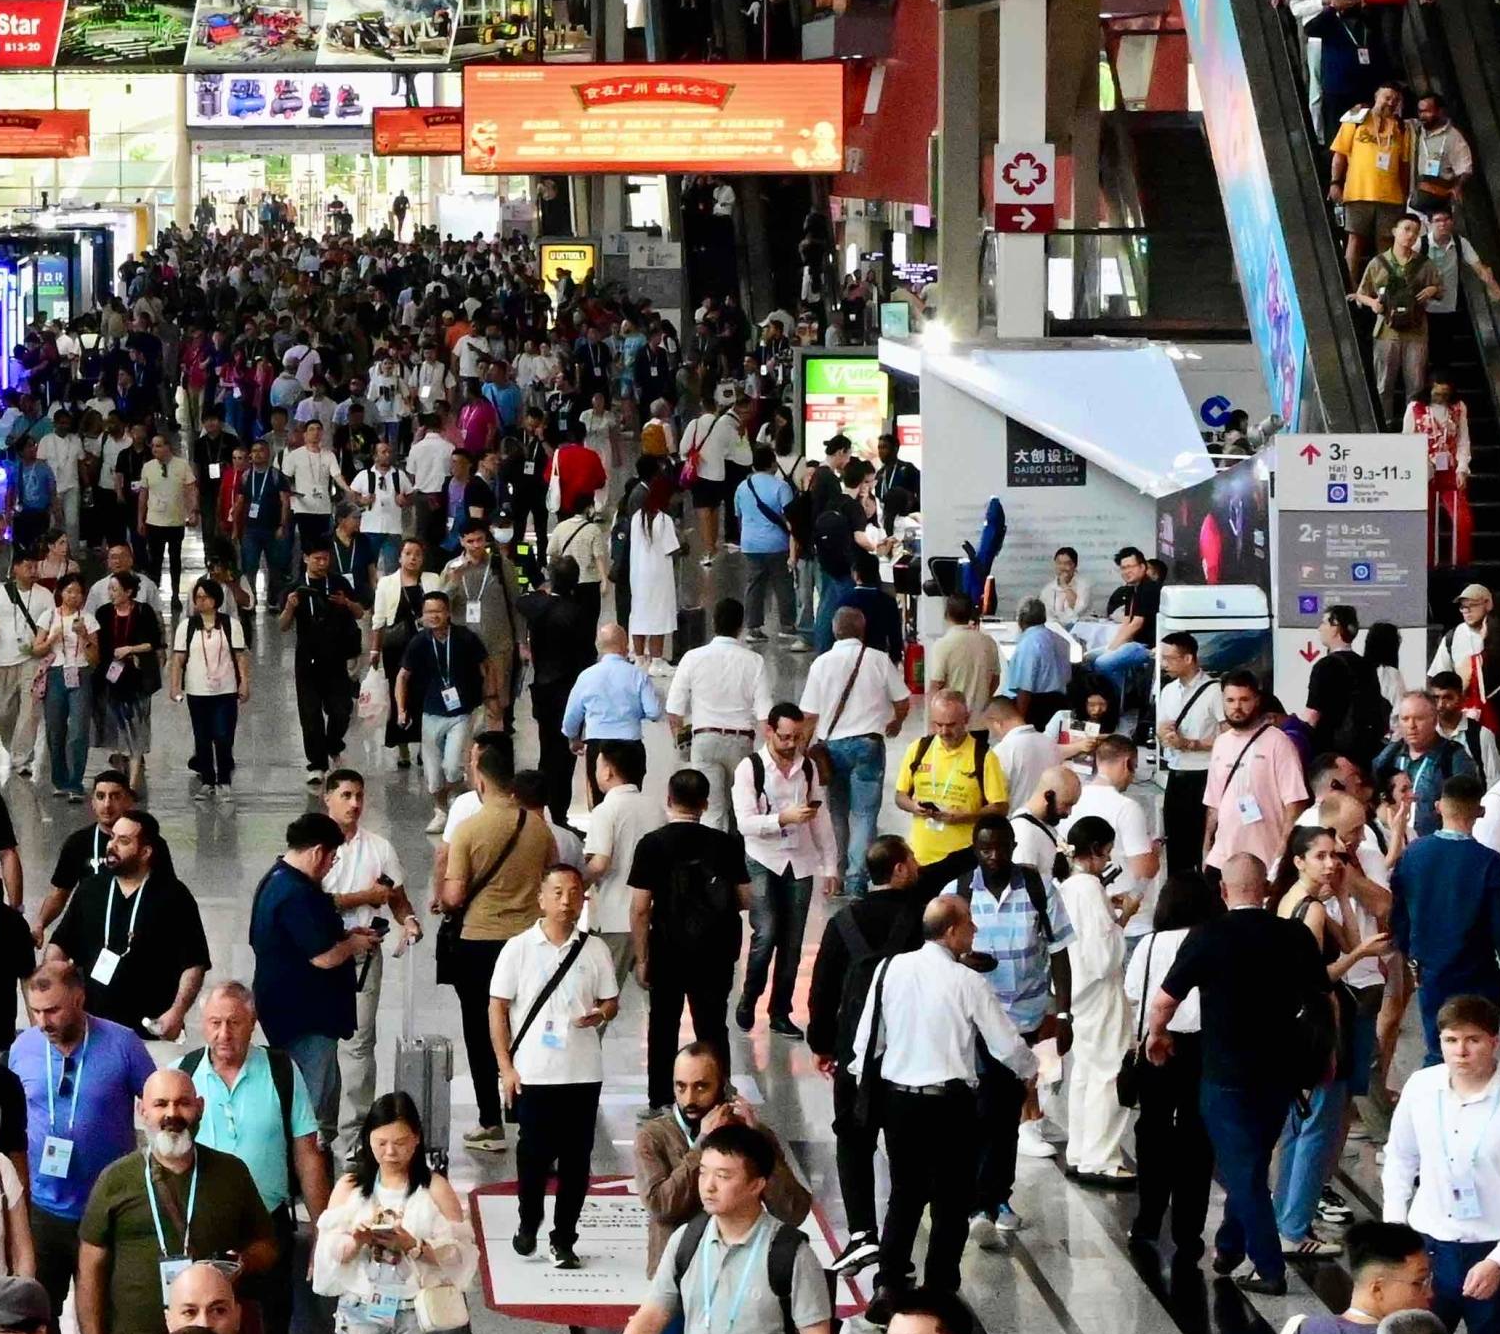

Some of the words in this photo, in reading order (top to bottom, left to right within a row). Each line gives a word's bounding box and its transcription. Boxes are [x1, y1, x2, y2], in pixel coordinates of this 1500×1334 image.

[1014, 448, 1077, 465] 大创设计
[1329, 442, 1351, 461] 3F
[1353, 464, 1412, 481] 9.3-11.3
[1298, 524, 1321, 543] 2F
